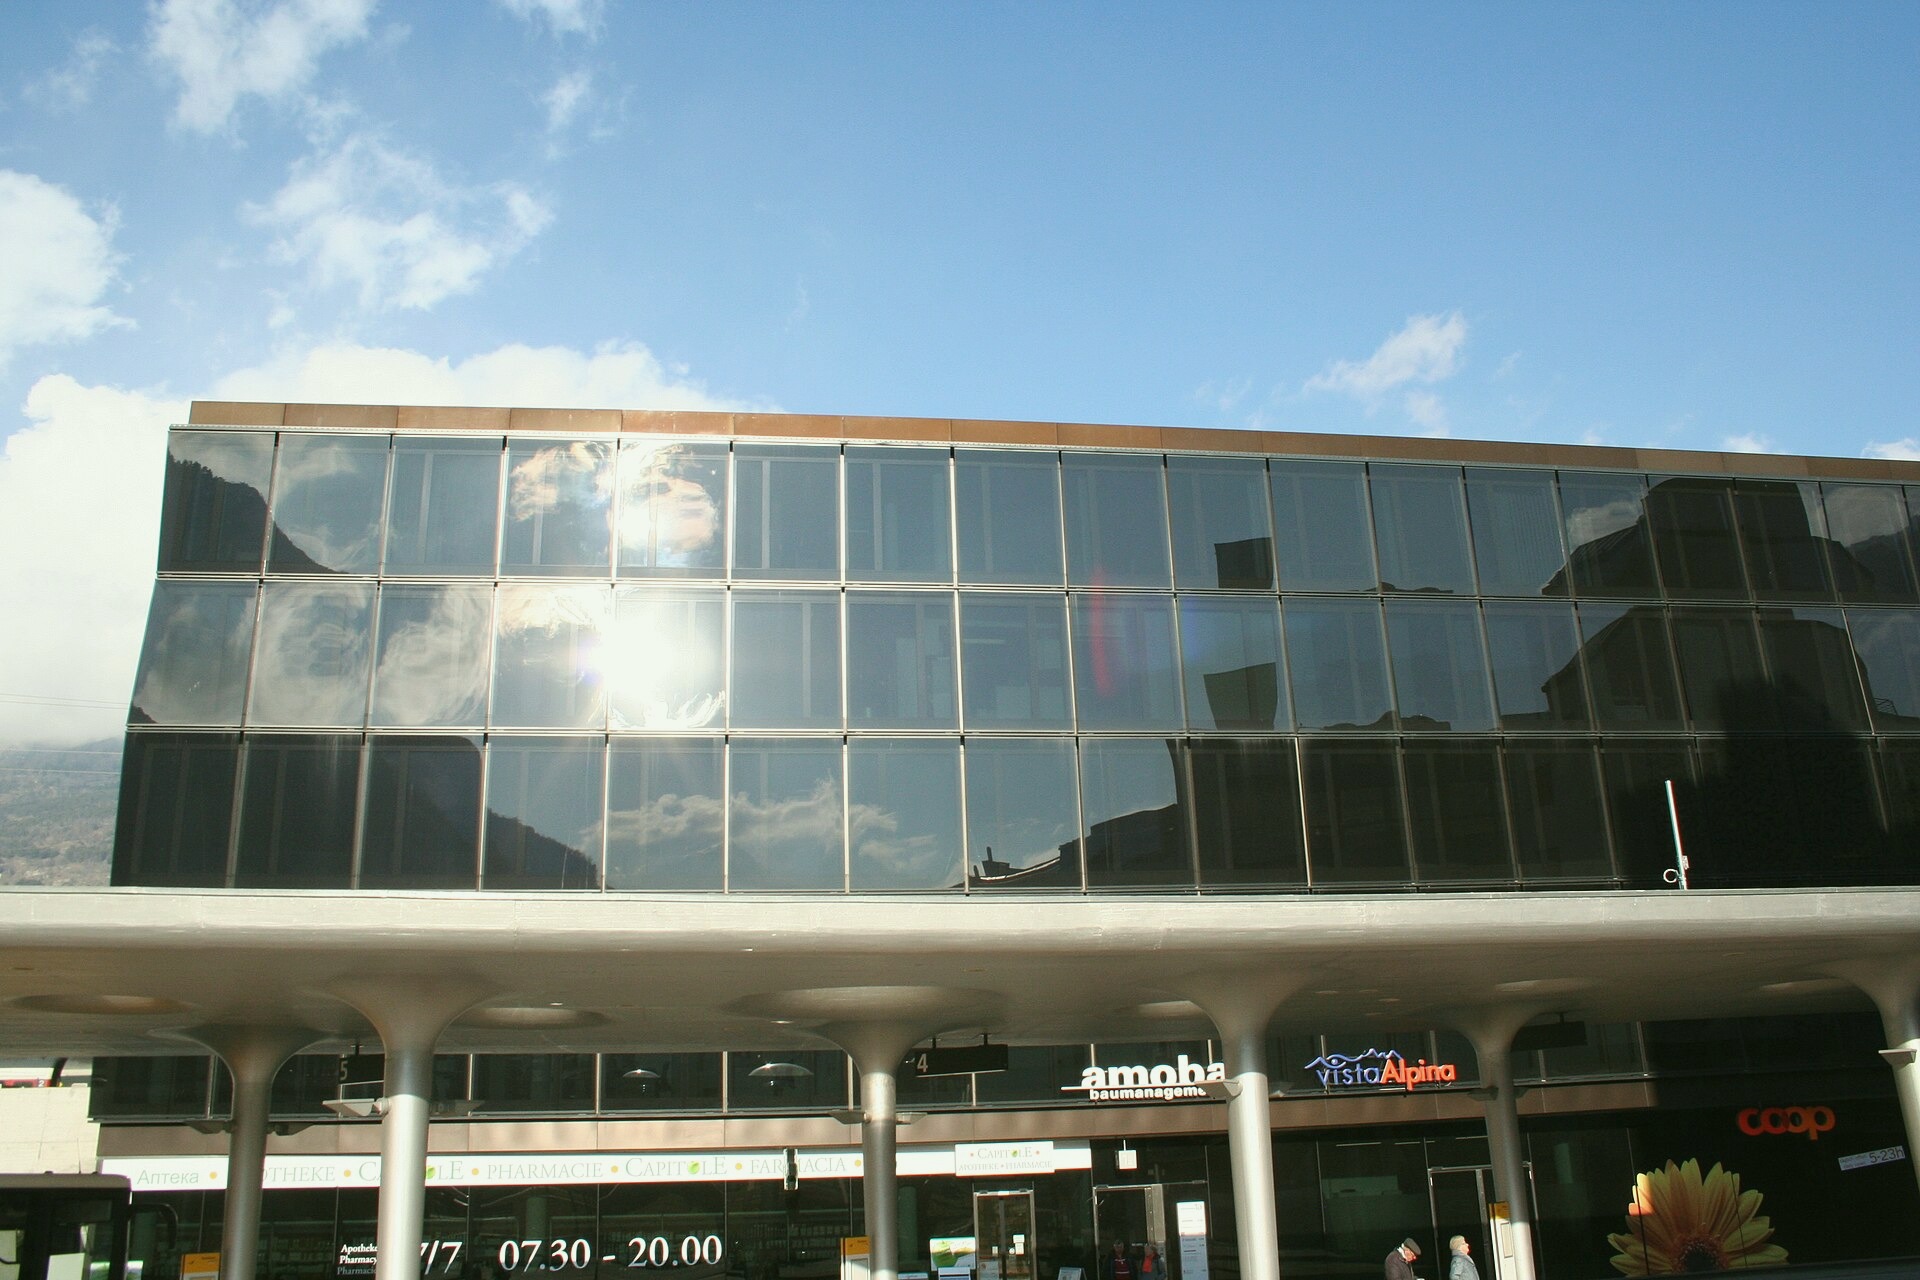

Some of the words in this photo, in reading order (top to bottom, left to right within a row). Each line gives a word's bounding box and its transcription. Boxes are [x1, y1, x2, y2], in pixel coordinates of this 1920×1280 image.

[340, 1060, 348, 1081] 5
[916, 1053, 928, 1073] 4
[1081, 1054, 1225, 1088] amoba
[1089, 1086, 1207, 1100] baumanageme
[1738, 1106, 1836, 1142] coop
[136, 1169, 199, 1185] Аптека
[263, 1166, 336, 1183] THEKE
[487, 1162, 603, 1180] PHARMACIE
[751, 1157, 847, 1175] FARACIA
[499, 1238, 591, 1272] 07.30
[627, 1234, 723, 1268] 20.00
